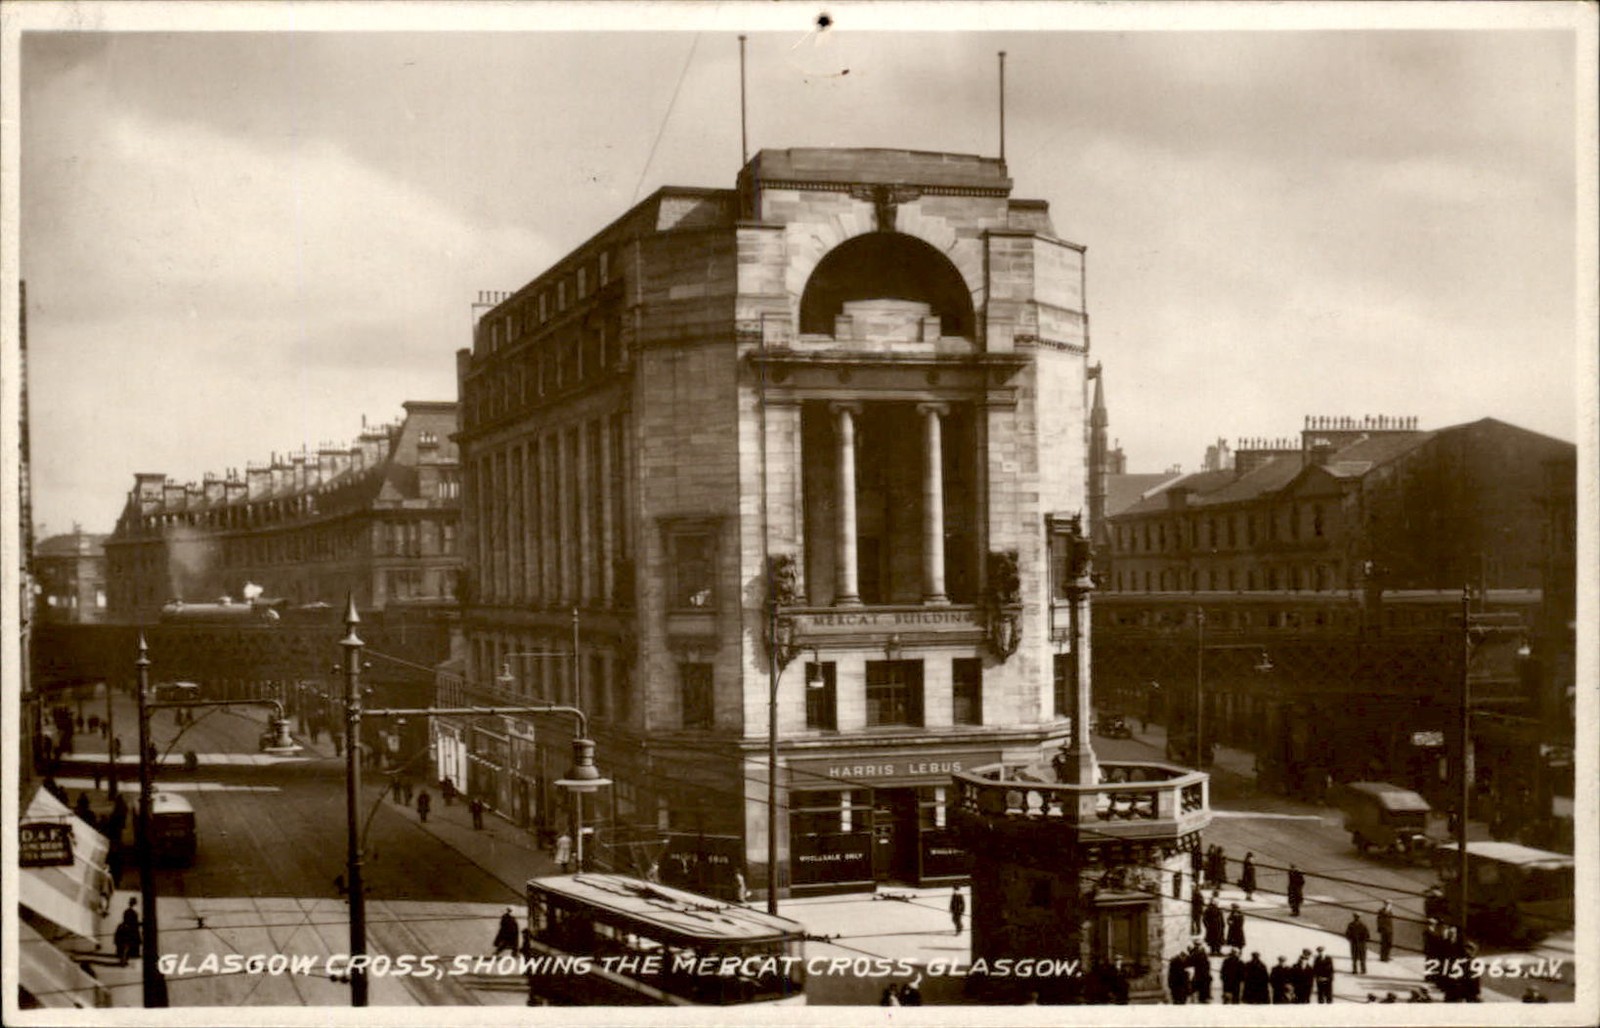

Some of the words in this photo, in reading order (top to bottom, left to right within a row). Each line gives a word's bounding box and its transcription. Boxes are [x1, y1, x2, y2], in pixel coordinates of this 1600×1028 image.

[814, 614, 879, 626] MERCAT
[895, 611, 971, 625] BUILDING
[829, 764, 894, 777] HARRIS
[909, 761, 962, 774] LEBUS
